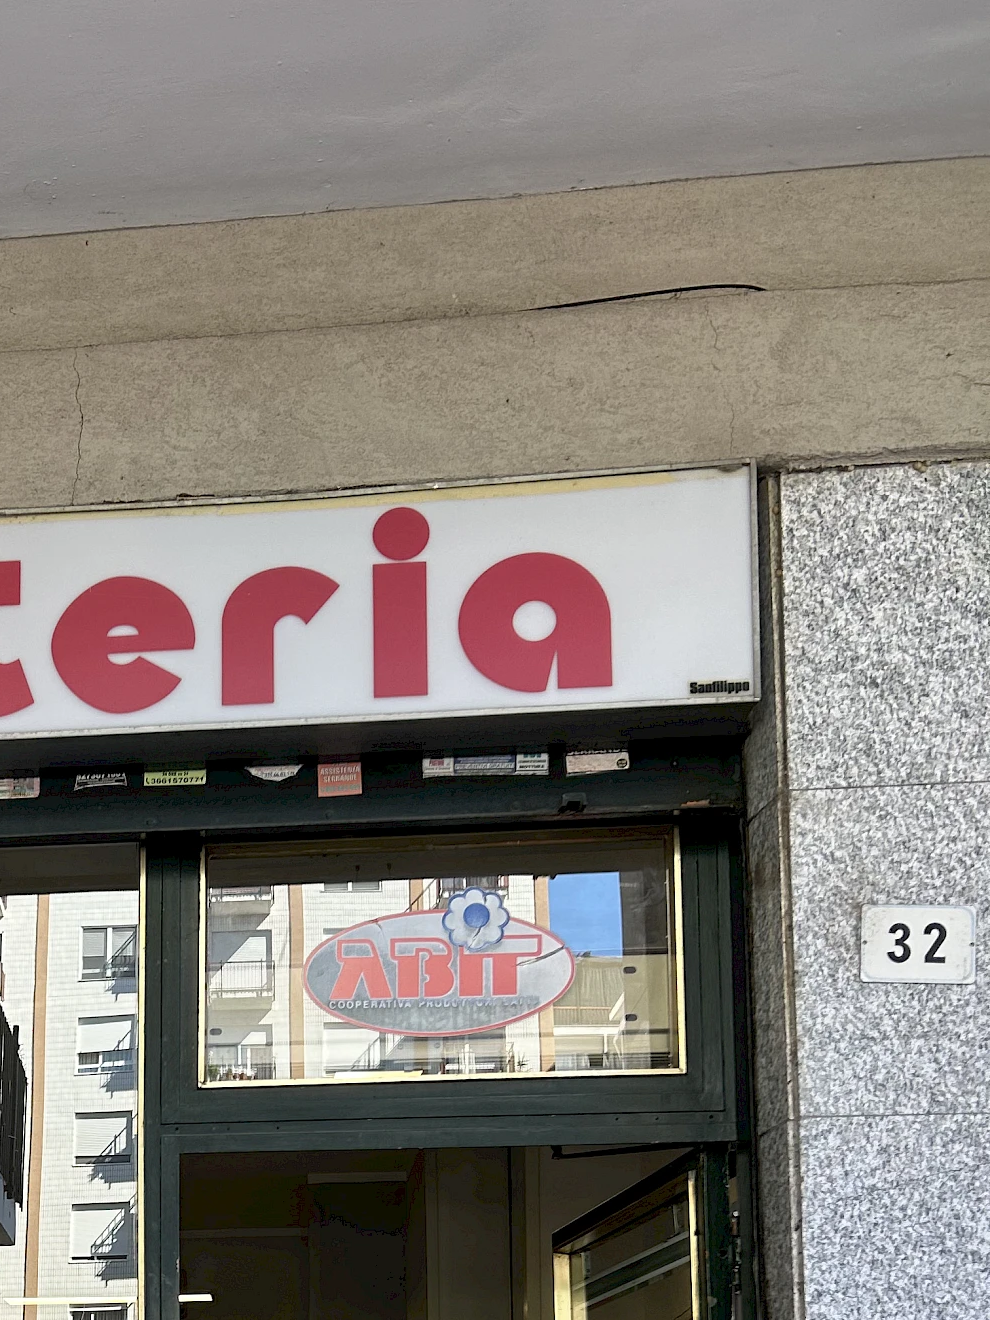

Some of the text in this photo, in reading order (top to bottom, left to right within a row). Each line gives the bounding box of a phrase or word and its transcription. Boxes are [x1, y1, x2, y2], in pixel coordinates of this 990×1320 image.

[689, 680, 750, 694] Sanfilippo
[887, 922, 947, 964] 32
[329, 934, 542, 999] ABIT
[328, 999, 412, 1010] COOPERATIVA
